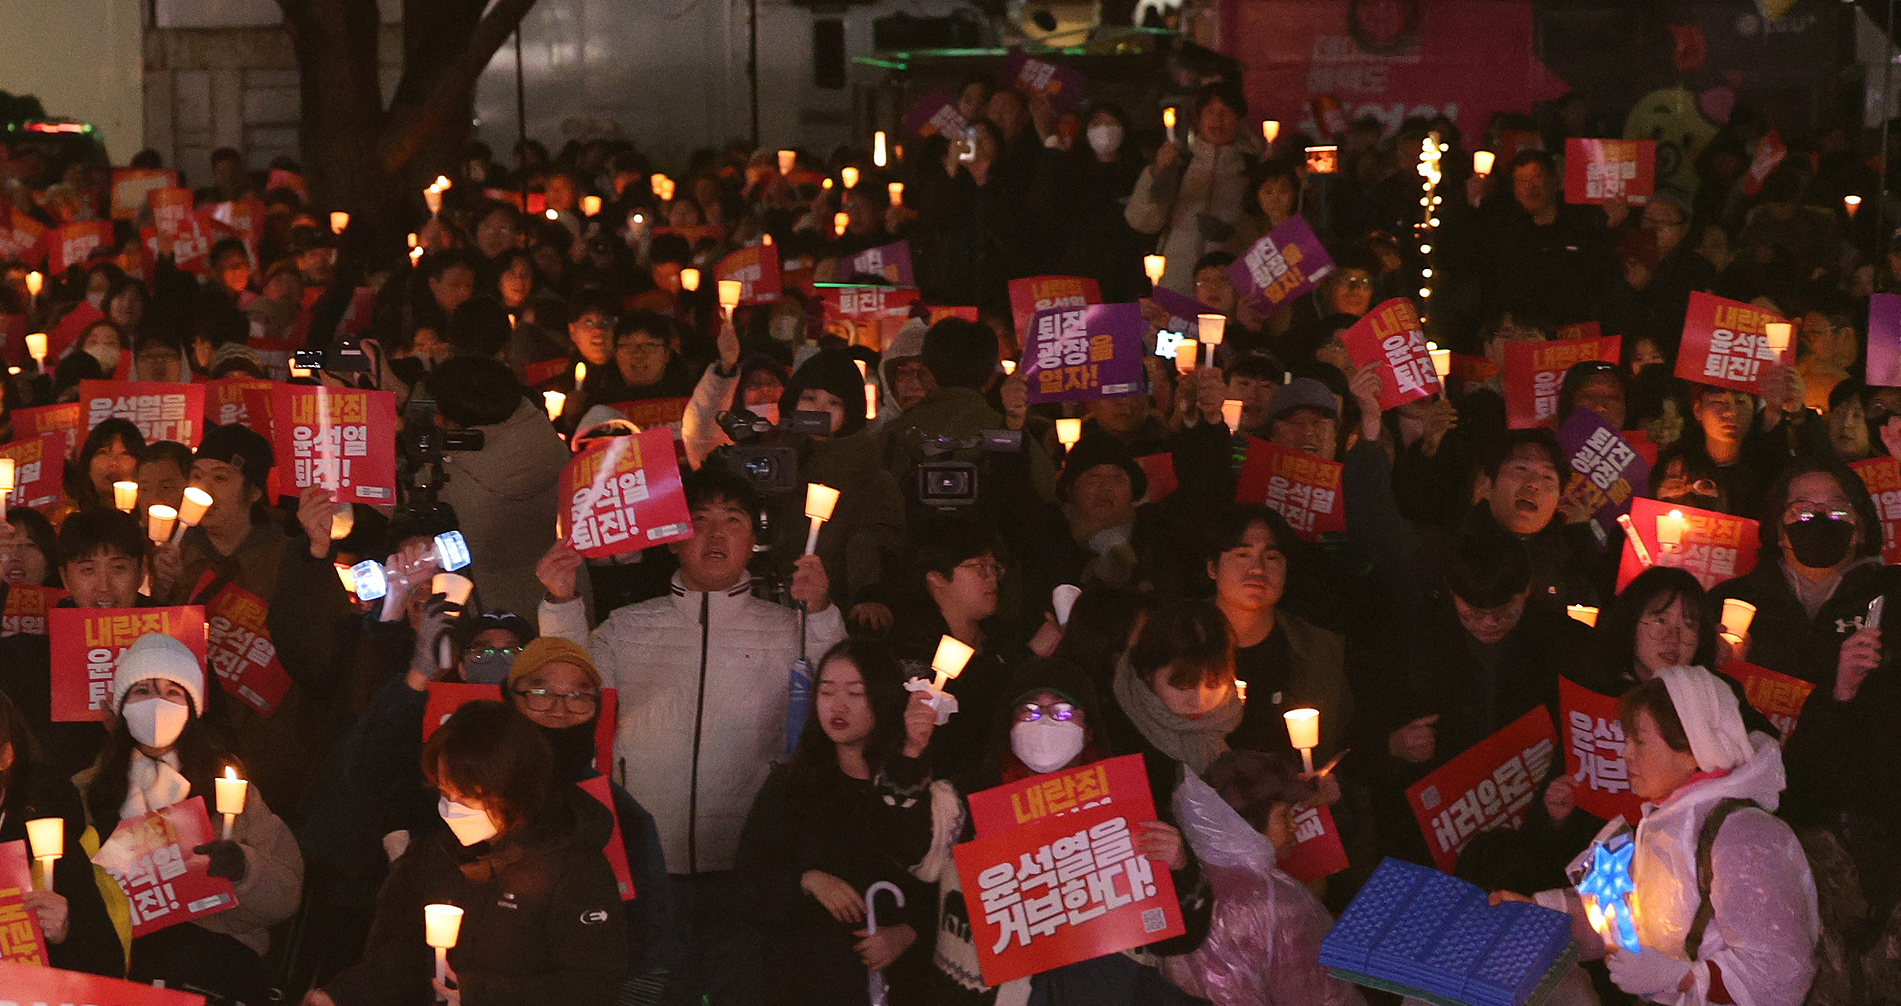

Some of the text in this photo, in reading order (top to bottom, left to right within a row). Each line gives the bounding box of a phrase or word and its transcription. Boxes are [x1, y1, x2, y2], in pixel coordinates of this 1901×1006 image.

[1037, 309, 1088, 342] 퇴진
[1370, 303, 1420, 339] 내란
[1037, 333, 1115, 371] 광장을
[1383, 330, 1428, 370] 윤석
[1534, 344, 1599, 371] 내란죄
[1704, 357, 1760, 382] 퇴진!
[1040, 366, 1098, 394] 열자!
[292, 394, 367, 426] 내란죄
[293, 426, 367, 456] 윤석열
[1586, 427, 1635, 470] 퇴진
[572, 438, 642, 491] 내란죄
[1272, 452, 1340, 489] 내란죄
[571, 469, 649, 516] 윤석열
[1266, 475, 1335, 515] 윤석열
[572, 508, 640, 551] 퇴진!
[85, 611, 170, 647] 내란죄
[209, 616, 276, 669] 윤석열
[1011, 766, 1110, 825] 내란죄
[978, 816, 1135, 911] 윤석열을
[985, 854, 1158, 955] 거부한다!
